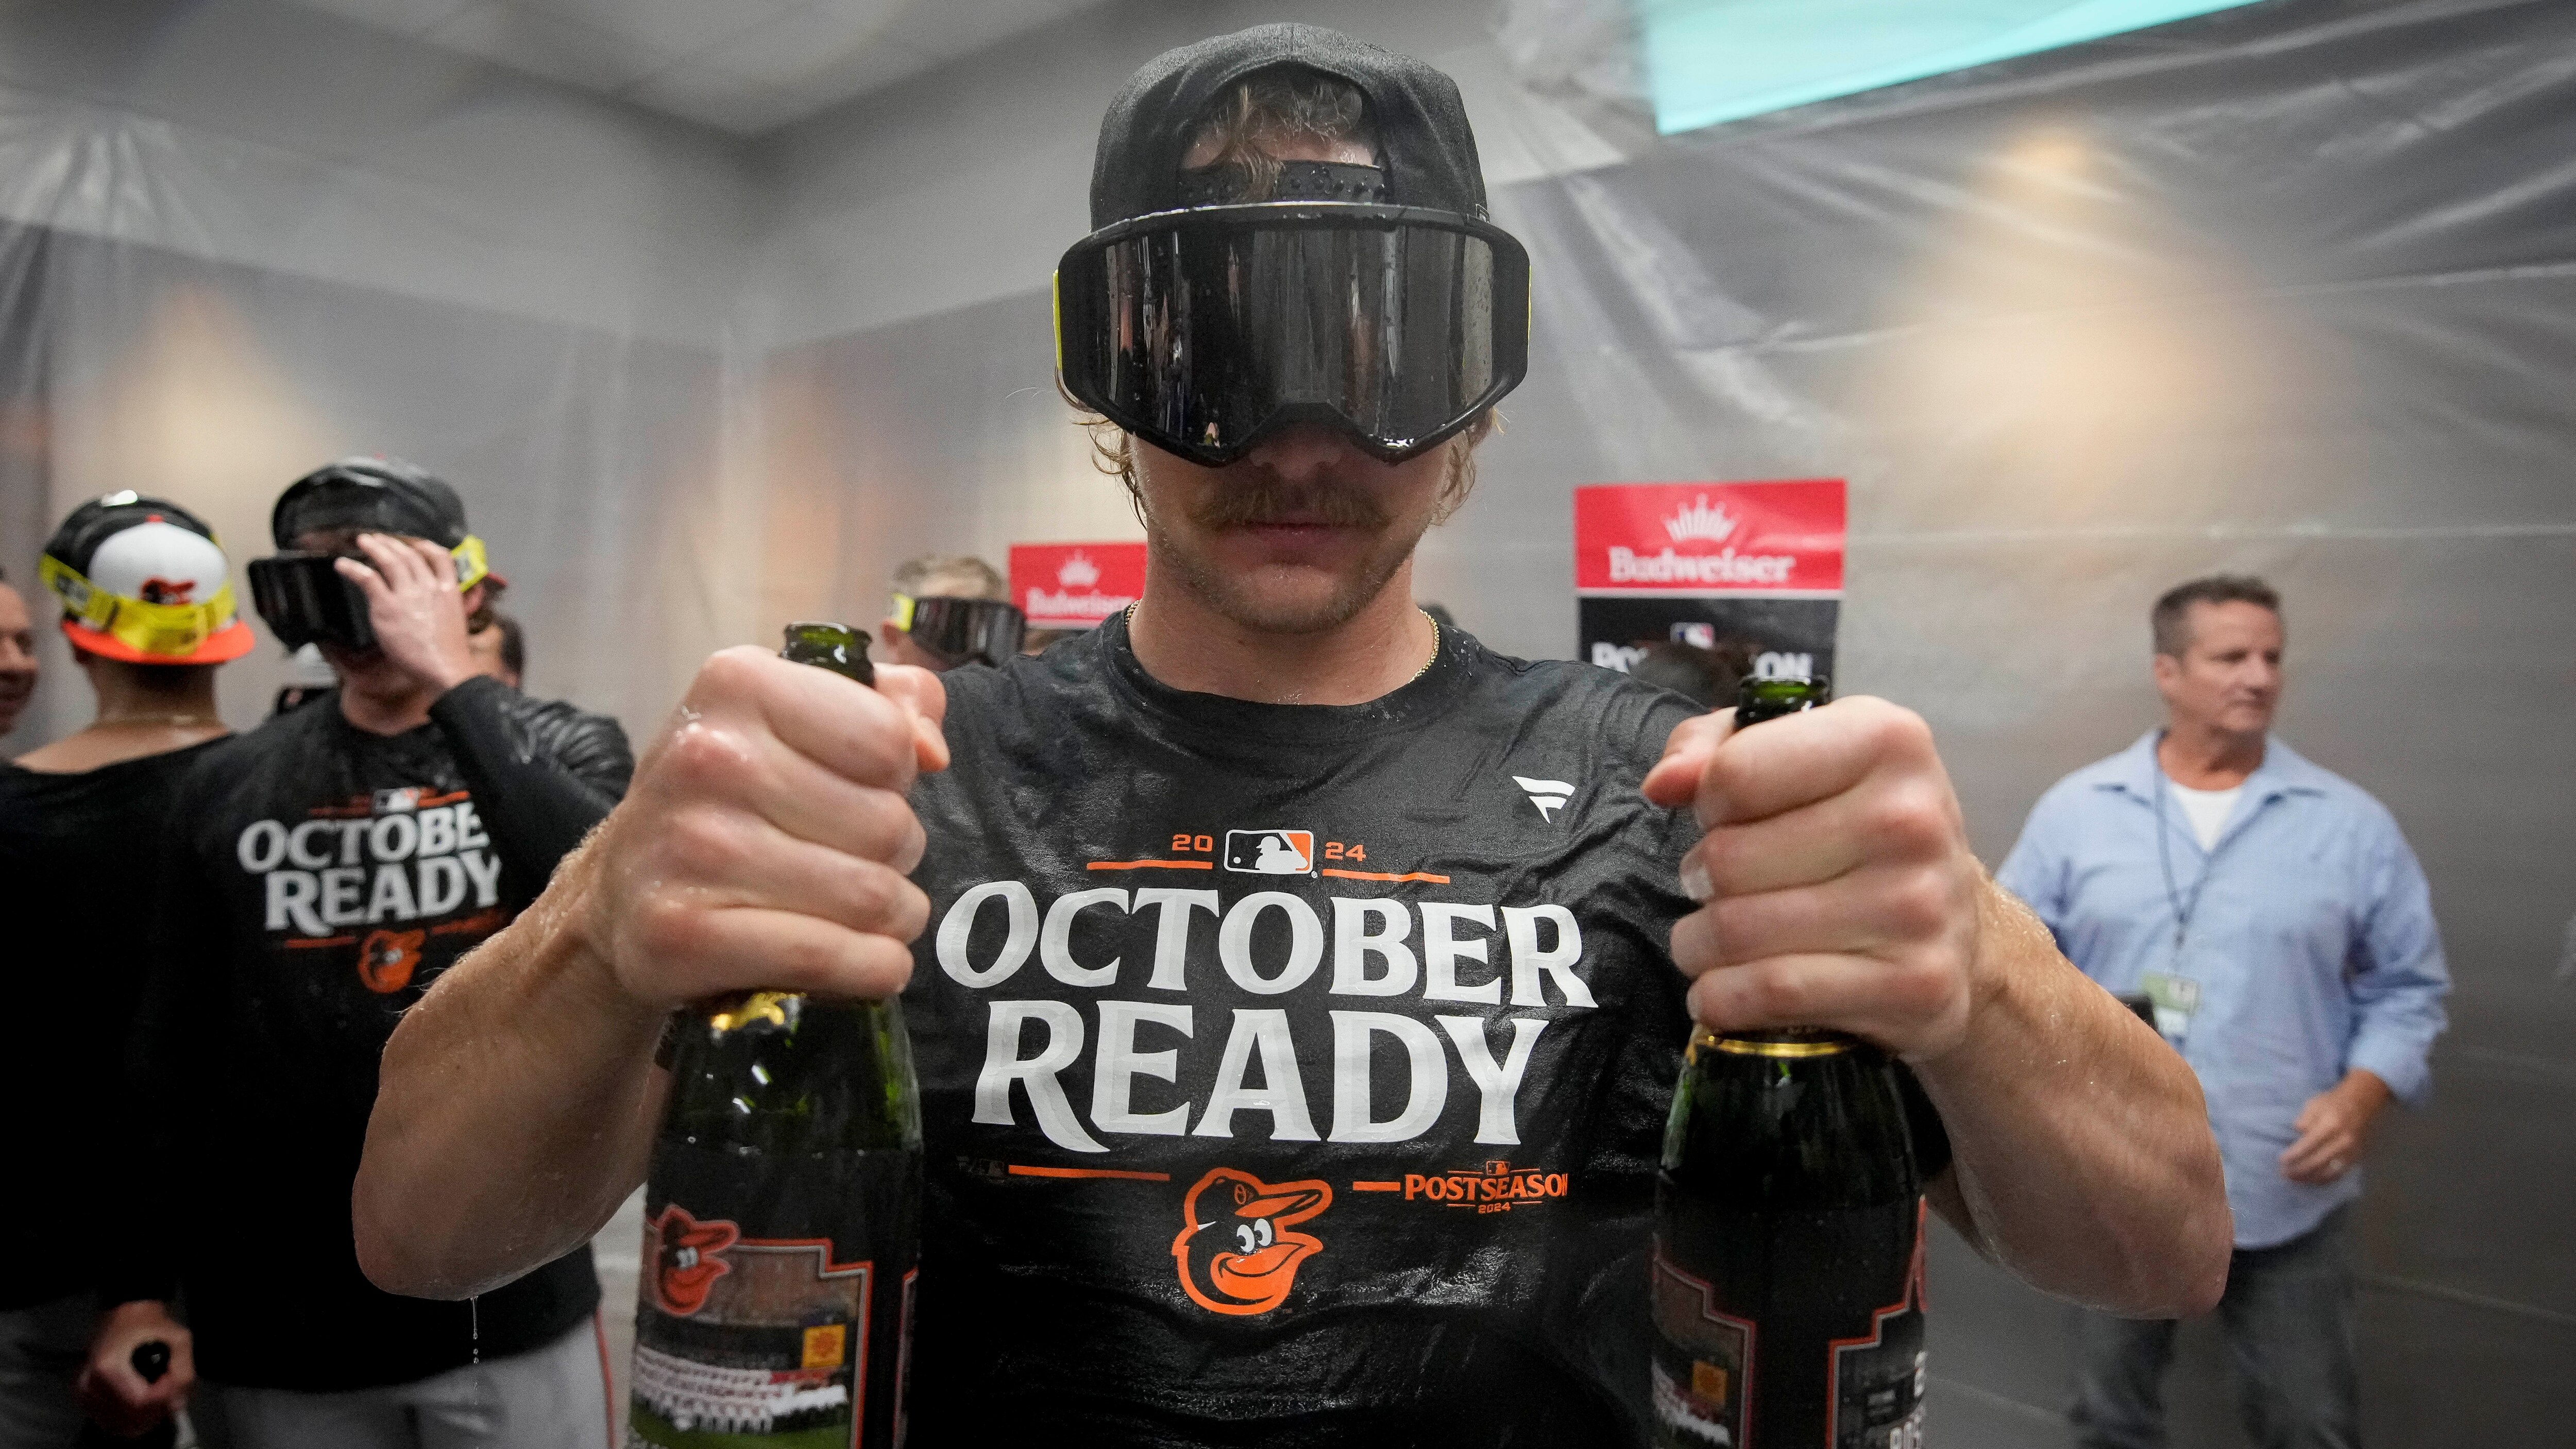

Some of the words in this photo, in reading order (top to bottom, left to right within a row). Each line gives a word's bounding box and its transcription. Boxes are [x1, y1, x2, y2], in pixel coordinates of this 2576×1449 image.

[1608, 546, 1797, 583] Budweiser
[237, 802, 490, 873] OCTOBE
[1172, 833, 1213, 853] 20
[1324, 841, 1365, 862] 24
[265, 849, 502, 937] READY
[935, 880, 1599, 1008] OCTOBER
[971, 1000, 1550, 1153] READY
[1478, 1202, 1511, 1214] 2024
